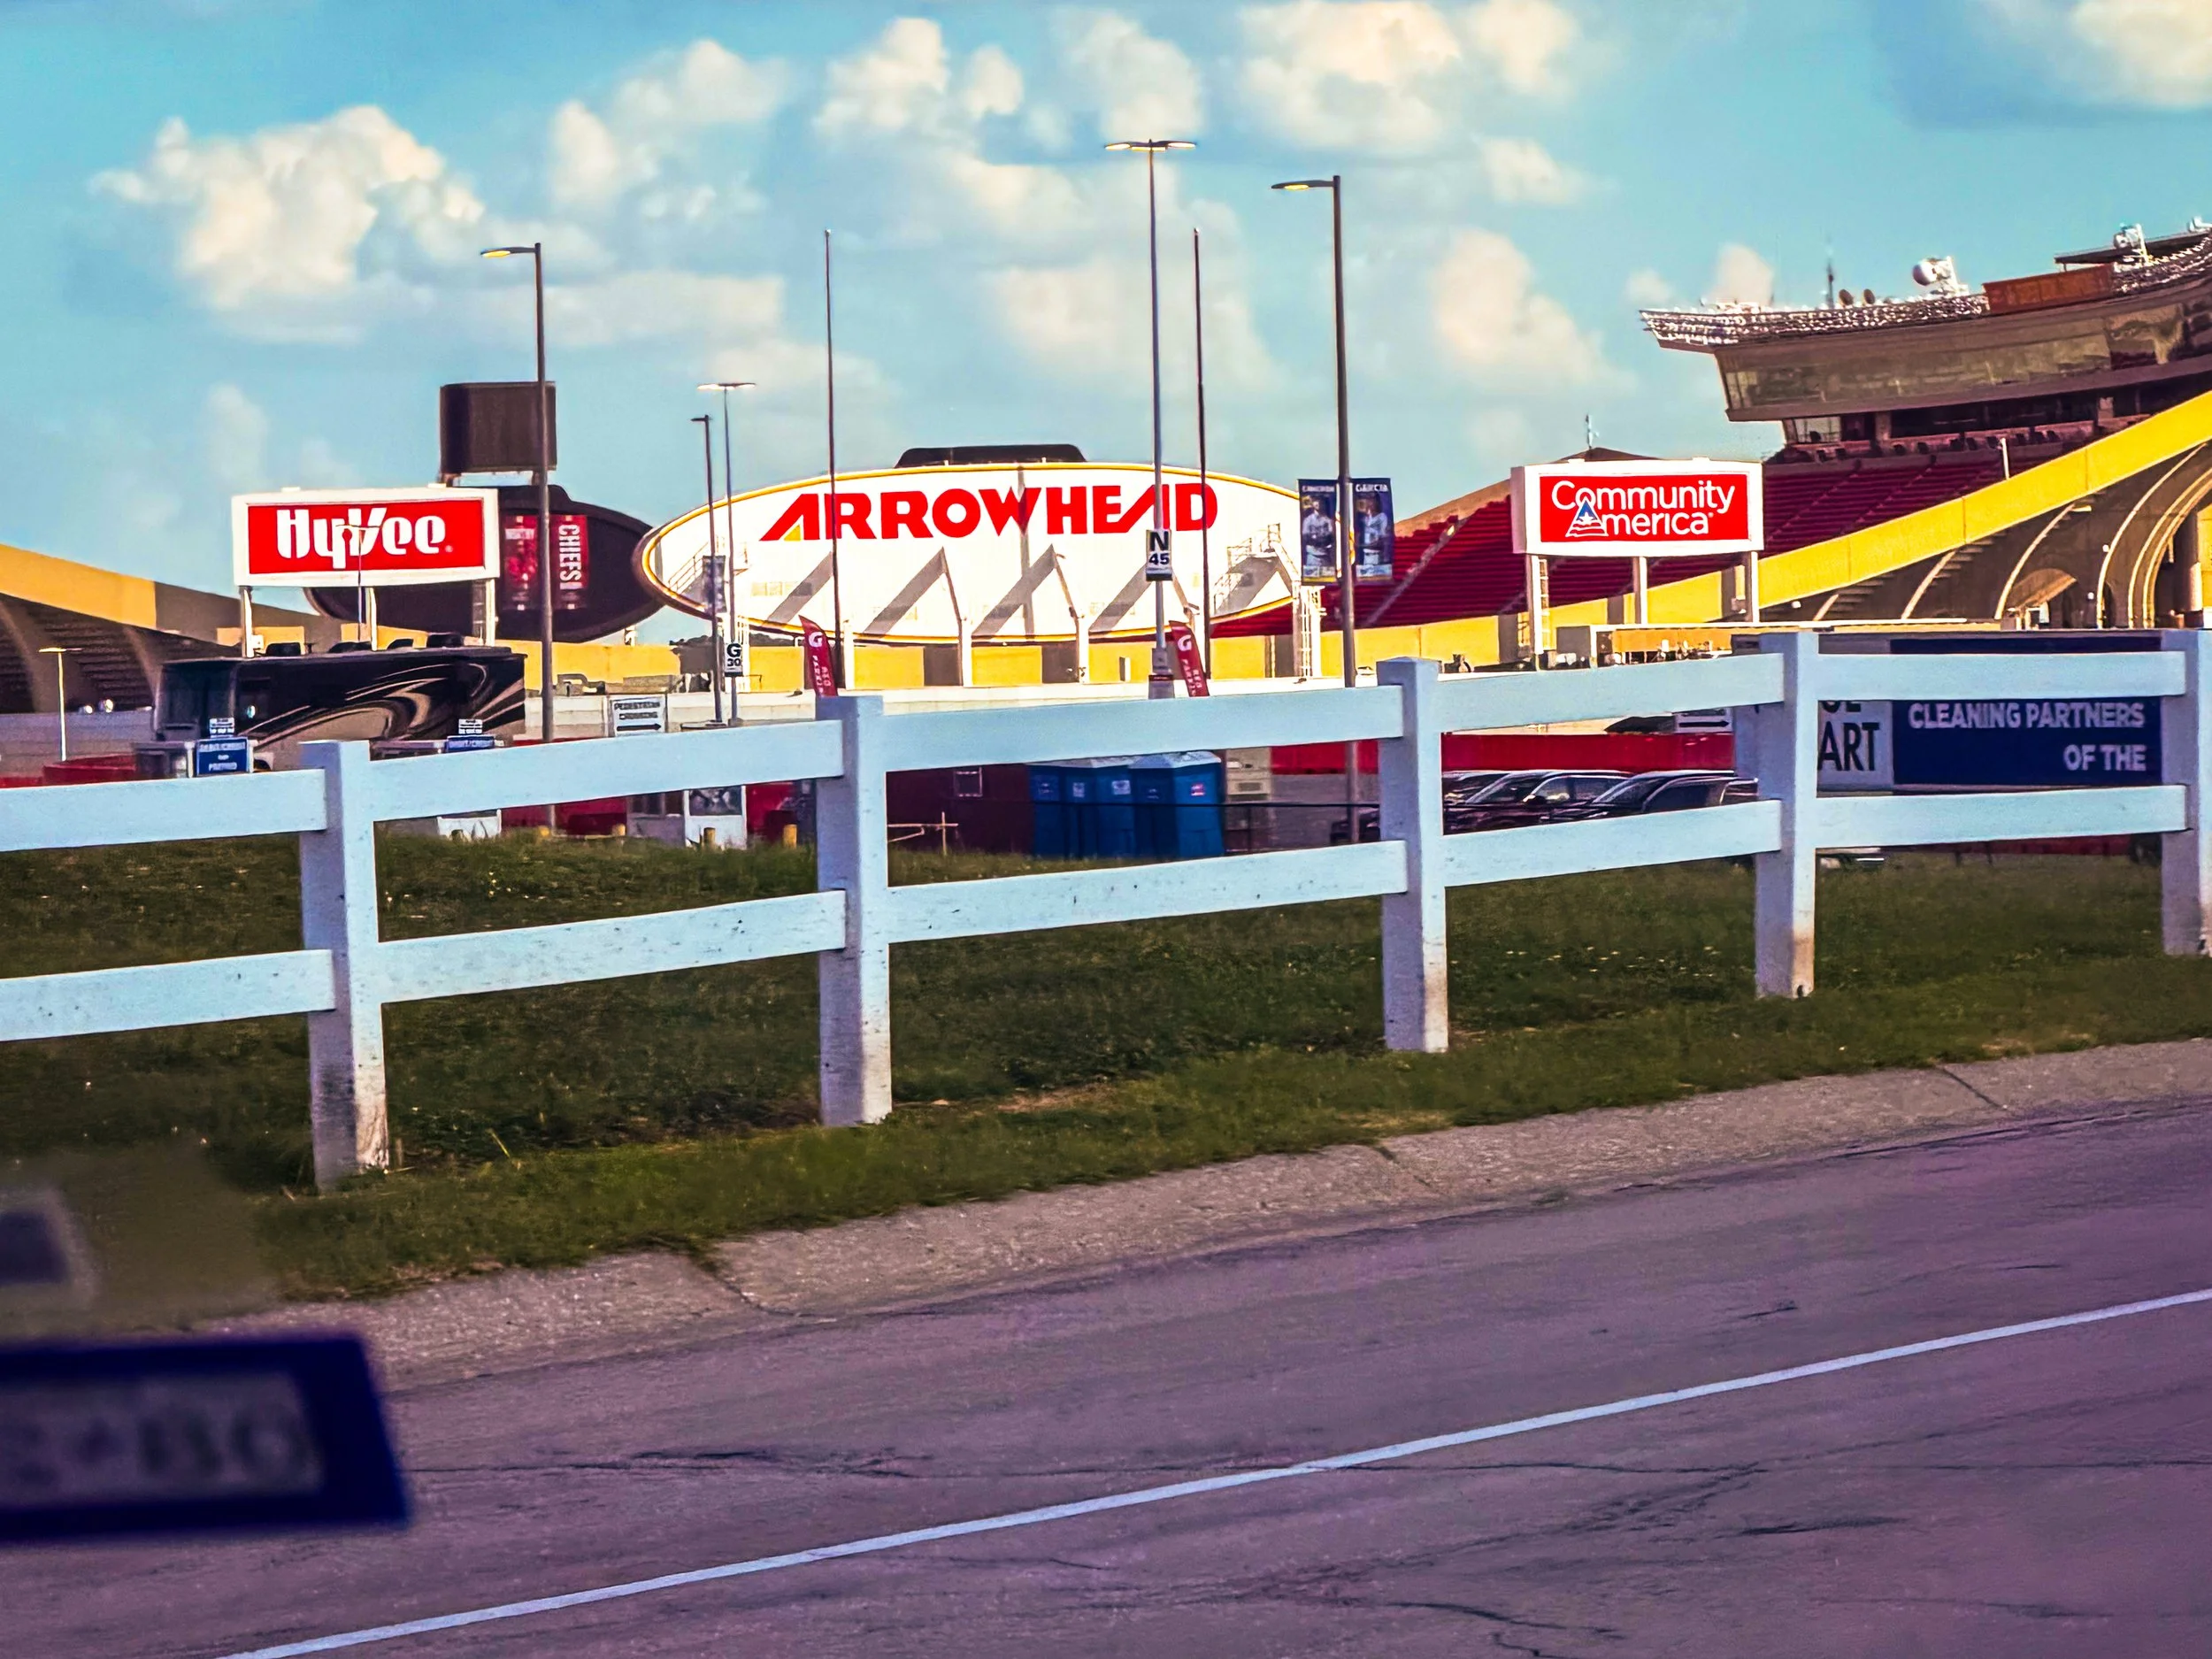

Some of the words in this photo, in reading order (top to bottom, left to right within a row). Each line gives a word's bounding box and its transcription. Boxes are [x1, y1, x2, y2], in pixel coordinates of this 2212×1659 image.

[1551, 480, 1735, 513] Community
[759, 482, 1217, 541] ARROWHEAD
[1149, 531, 1169, 551] N
[1148, 552, 1170, 565] 45
[726, 643, 741, 657] G
[809, 632, 823, 647] G
[1178, 634, 1192, 651] G
[1909, 703, 2021, 728] CLEANING
[2026, 703, 2145, 727] PARTNERS
[1817, 721, 1879, 771] ART
[2063, 745, 2095, 771] OF
[2101, 745, 2146, 771] THE
